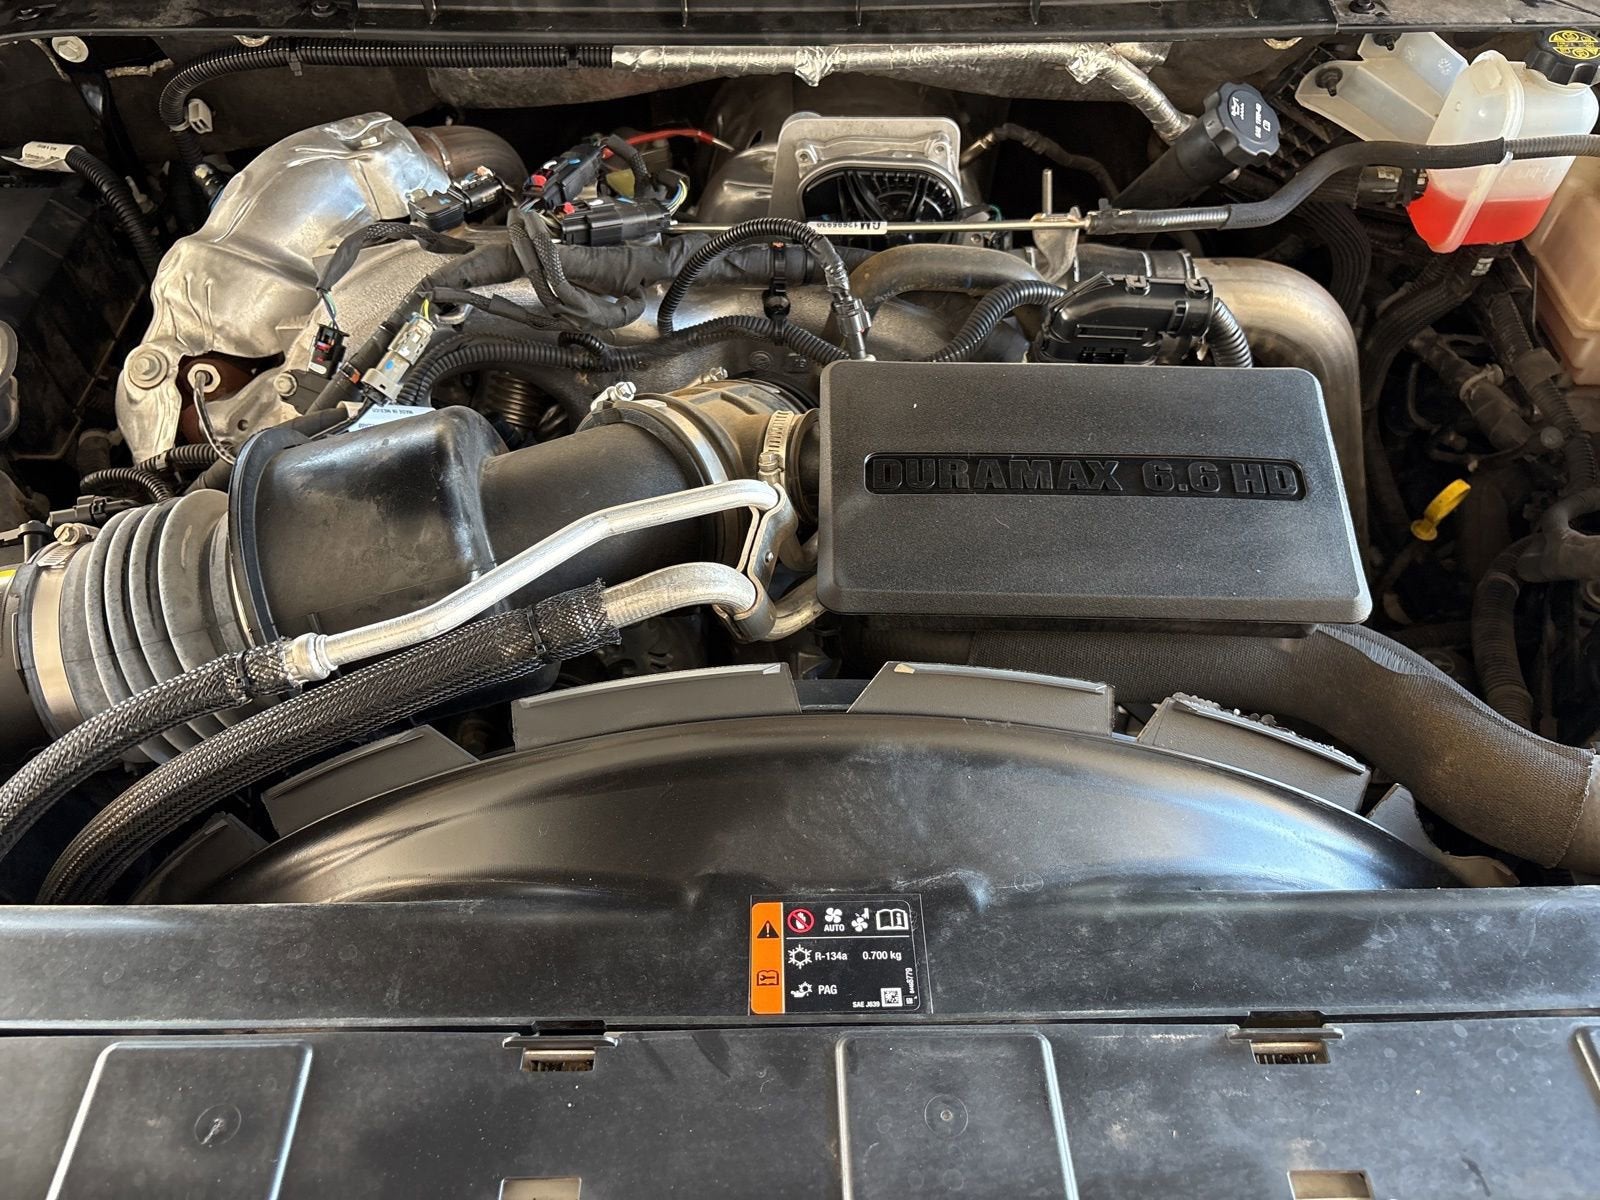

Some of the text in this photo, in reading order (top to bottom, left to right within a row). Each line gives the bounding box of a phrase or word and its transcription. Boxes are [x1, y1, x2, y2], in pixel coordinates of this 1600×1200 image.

[861, 222, 880, 230] GM
[872, 458, 1300, 497] DURAMAX 6.6 HD
[824, 924, 845, 932] AUTO
[815, 951, 902, 961] R-134a 0.700 kg
[818, 984, 838, 995] PAG
